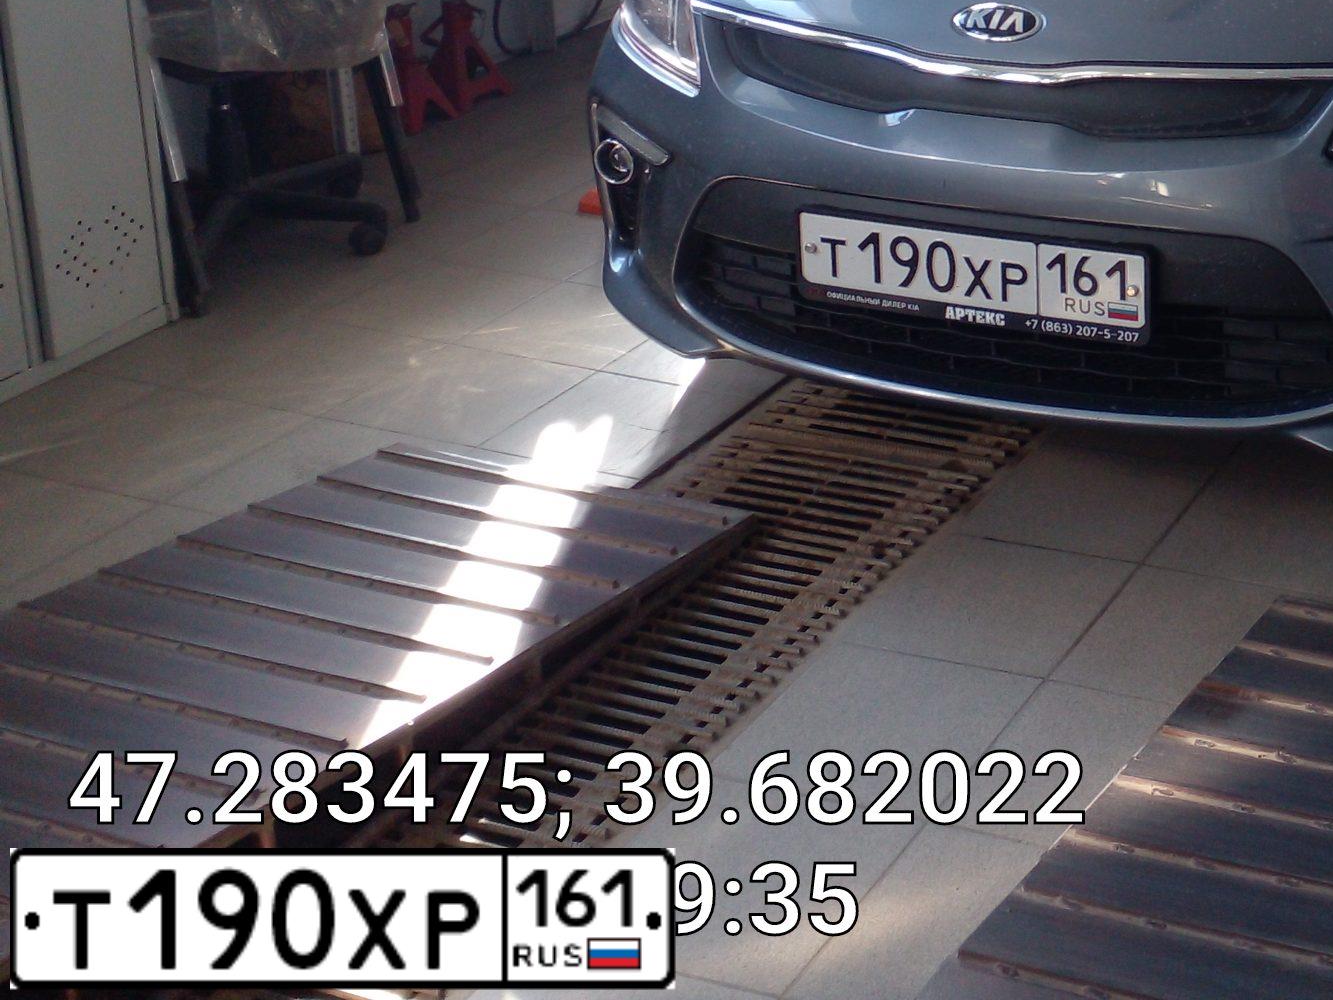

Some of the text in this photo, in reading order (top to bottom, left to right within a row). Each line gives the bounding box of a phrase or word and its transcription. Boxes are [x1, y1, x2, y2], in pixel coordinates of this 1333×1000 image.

[966, 9, 1024, 33] KIA
[1046, 253, 1128, 301] 161
[881, 298, 906, 310] ДИЛЕР
[1064, 297, 1106, 316] RUS
[944, 305, 1006, 327] АРТЕКС
[1025, 319, 1140, 343] +7 (863) 207-5-207
